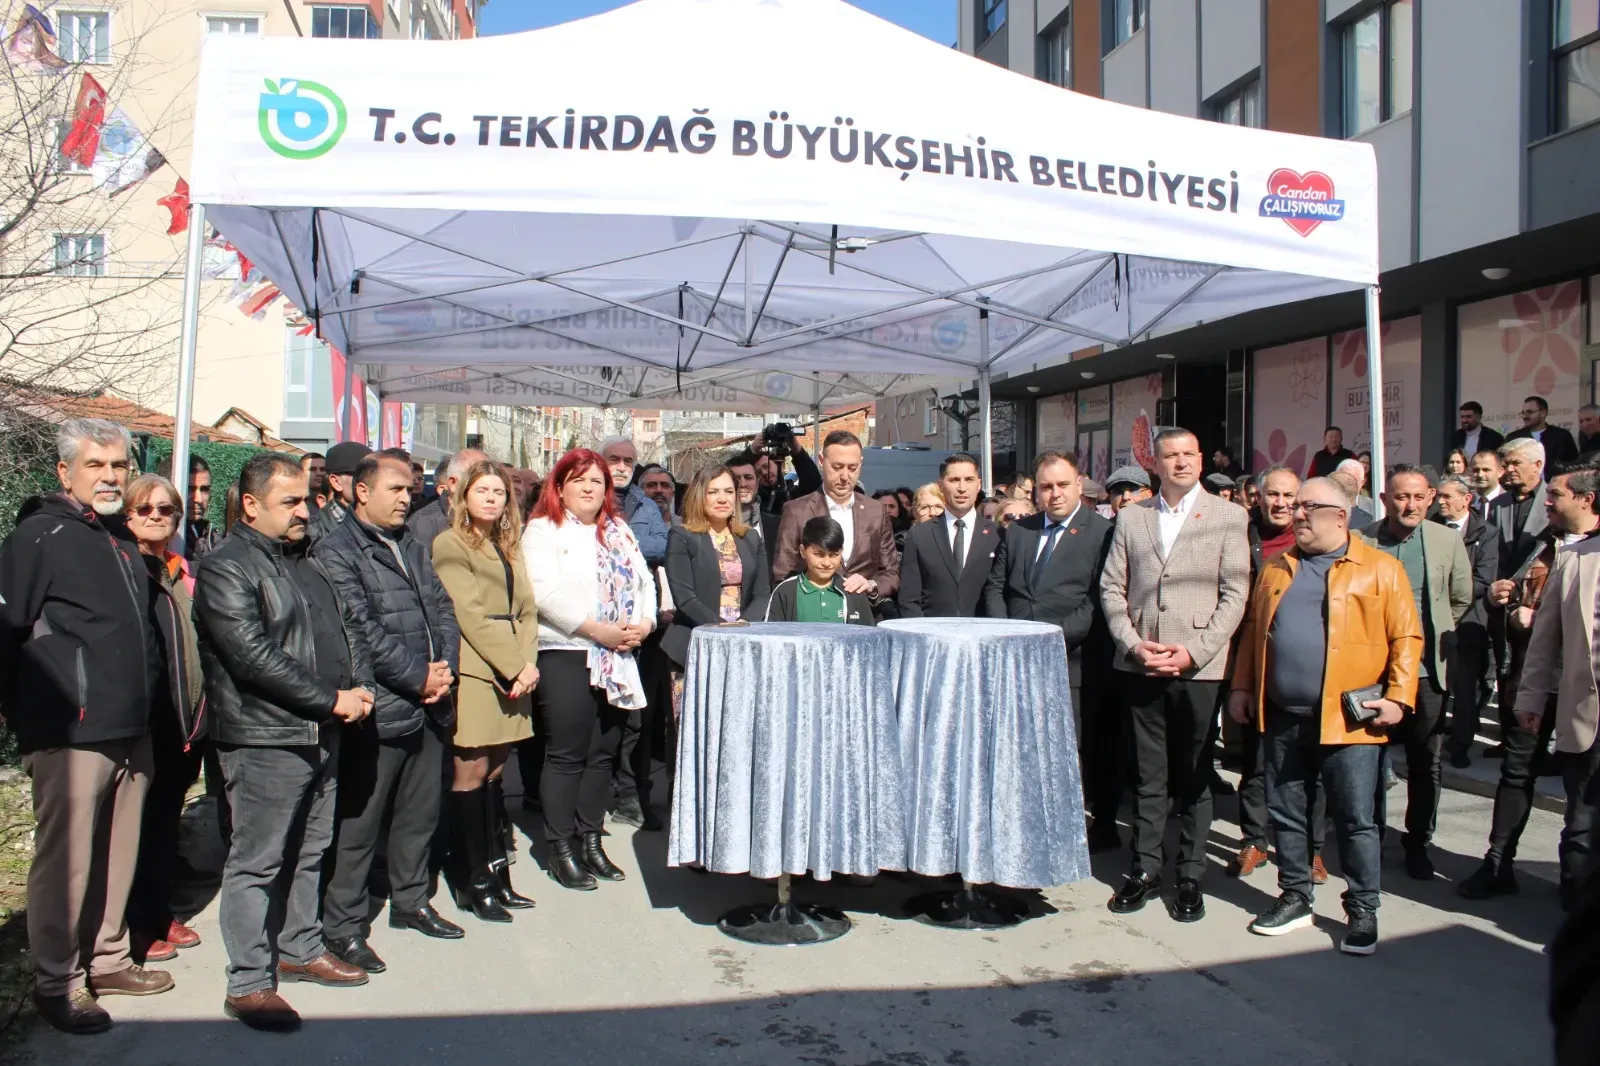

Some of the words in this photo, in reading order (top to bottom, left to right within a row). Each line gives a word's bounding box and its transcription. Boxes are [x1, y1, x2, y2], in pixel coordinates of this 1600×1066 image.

[369, 107, 456, 145] T.C.
[472, 108, 717, 155] TEKİRDAĞ
[732, 110, 1019, 183] BÜYÜKŞEHİR
[1029, 155, 1239, 213] BELEDİYESİ
[1277, 184, 1327, 200] Candan
[1263, 198, 1341, 217] ÇALIŞIYORUZ
[1347, 391, 1363, 408] BU
[1366, 384, 1400, 405] HİR
